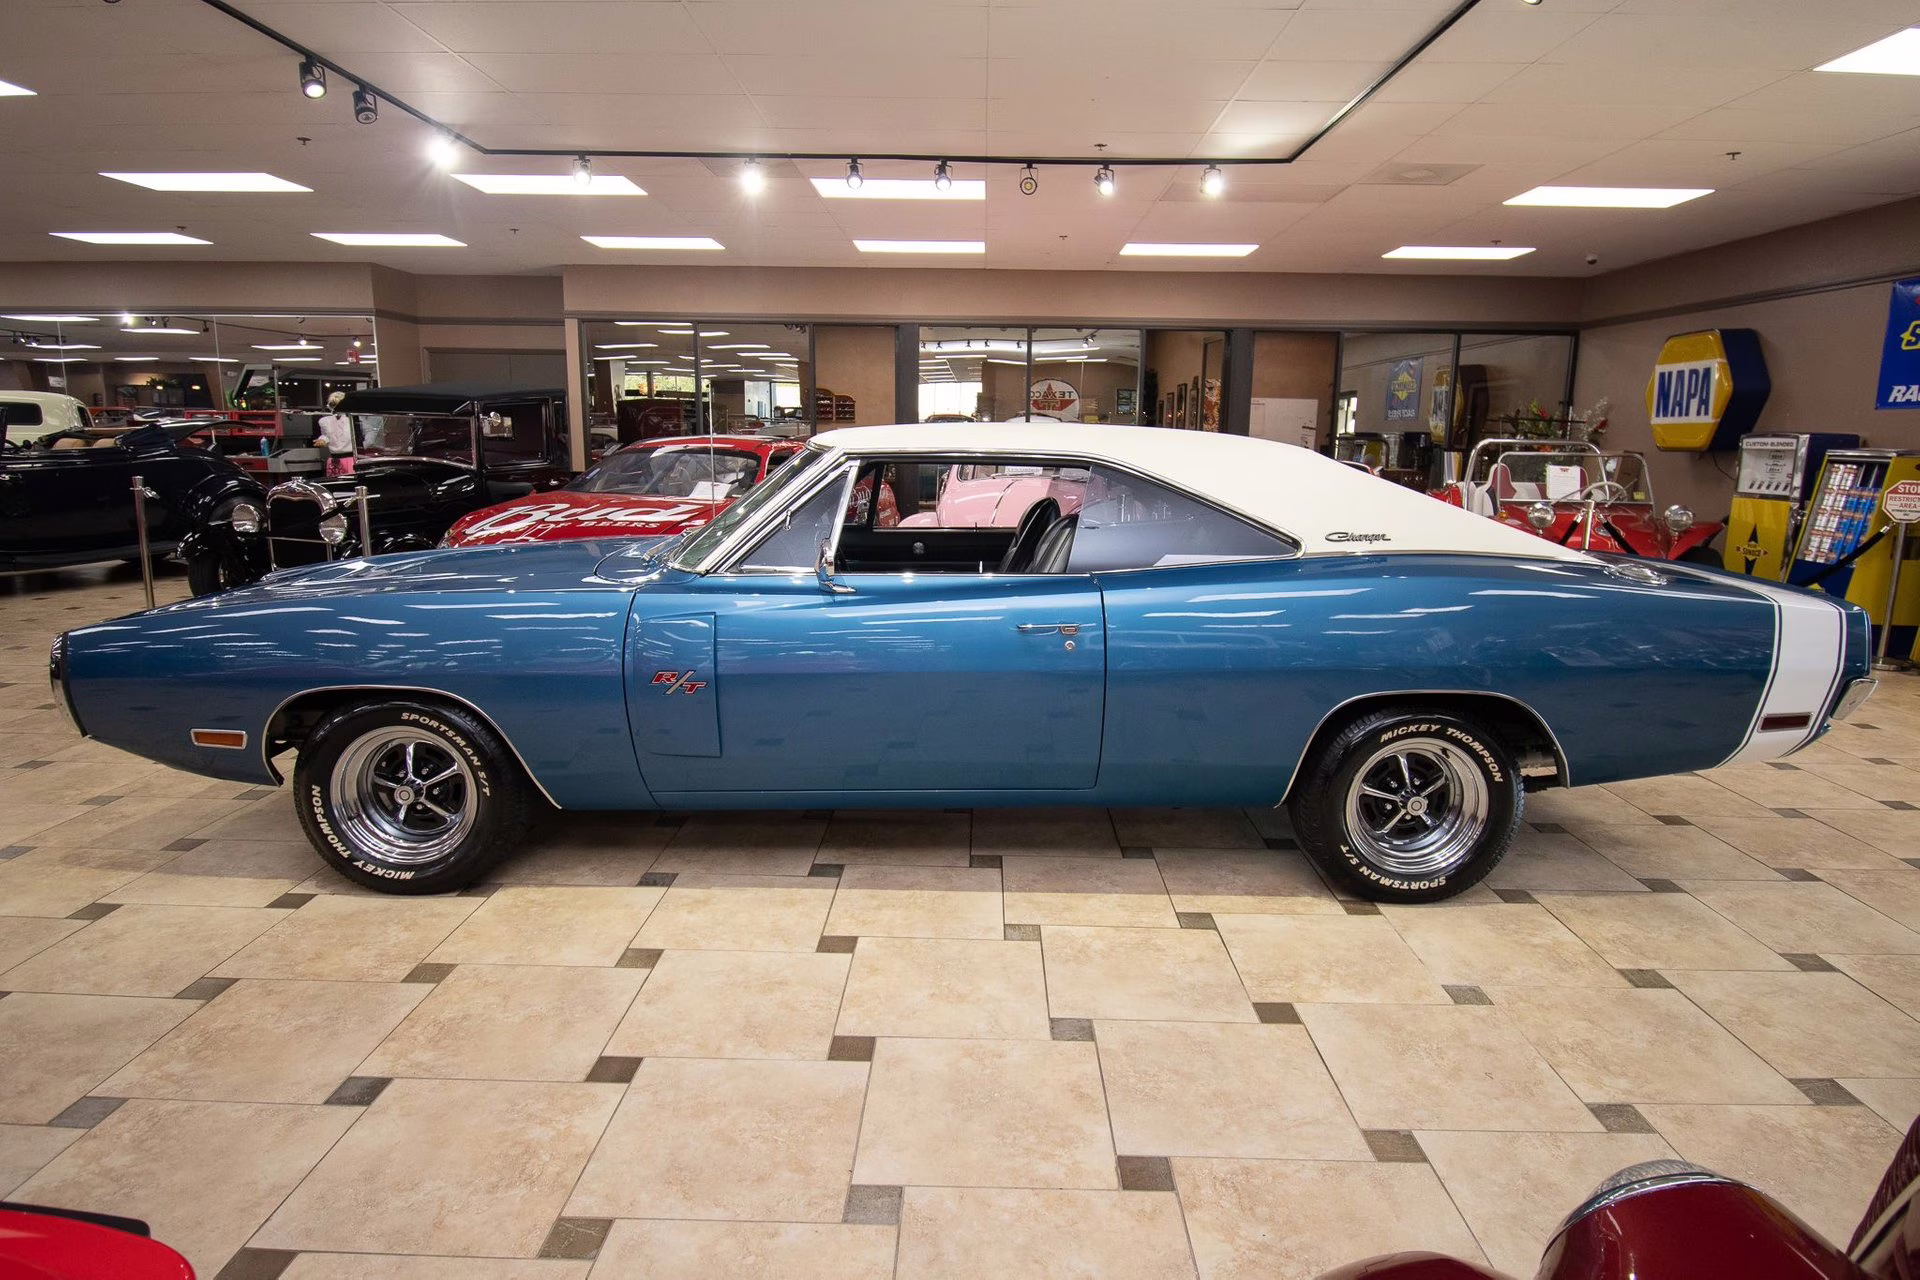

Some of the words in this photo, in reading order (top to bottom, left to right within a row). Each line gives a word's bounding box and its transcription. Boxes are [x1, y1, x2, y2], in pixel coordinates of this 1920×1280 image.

[1655, 367, 1711, 417] NAPA
[1888, 385, 1920, 402] RA
[576, 521, 661, 529] BEERS
[1325, 531, 1392, 544] Charger
[650, 669, 708, 695] R/T
[401, 712, 482, 767] SPORTSMAN
[478, 771, 491, 797] S/T
[1380, 724, 1441, 743] MICKEY
[1446, 727, 1503, 782] THOMPSON
[312, 784, 352, 858] THOMPSON
[1340, 844, 1359, 866] S/T
[353, 859, 415, 880] MICKEY
[1358, 865, 1447, 890] SPORTSMAN
